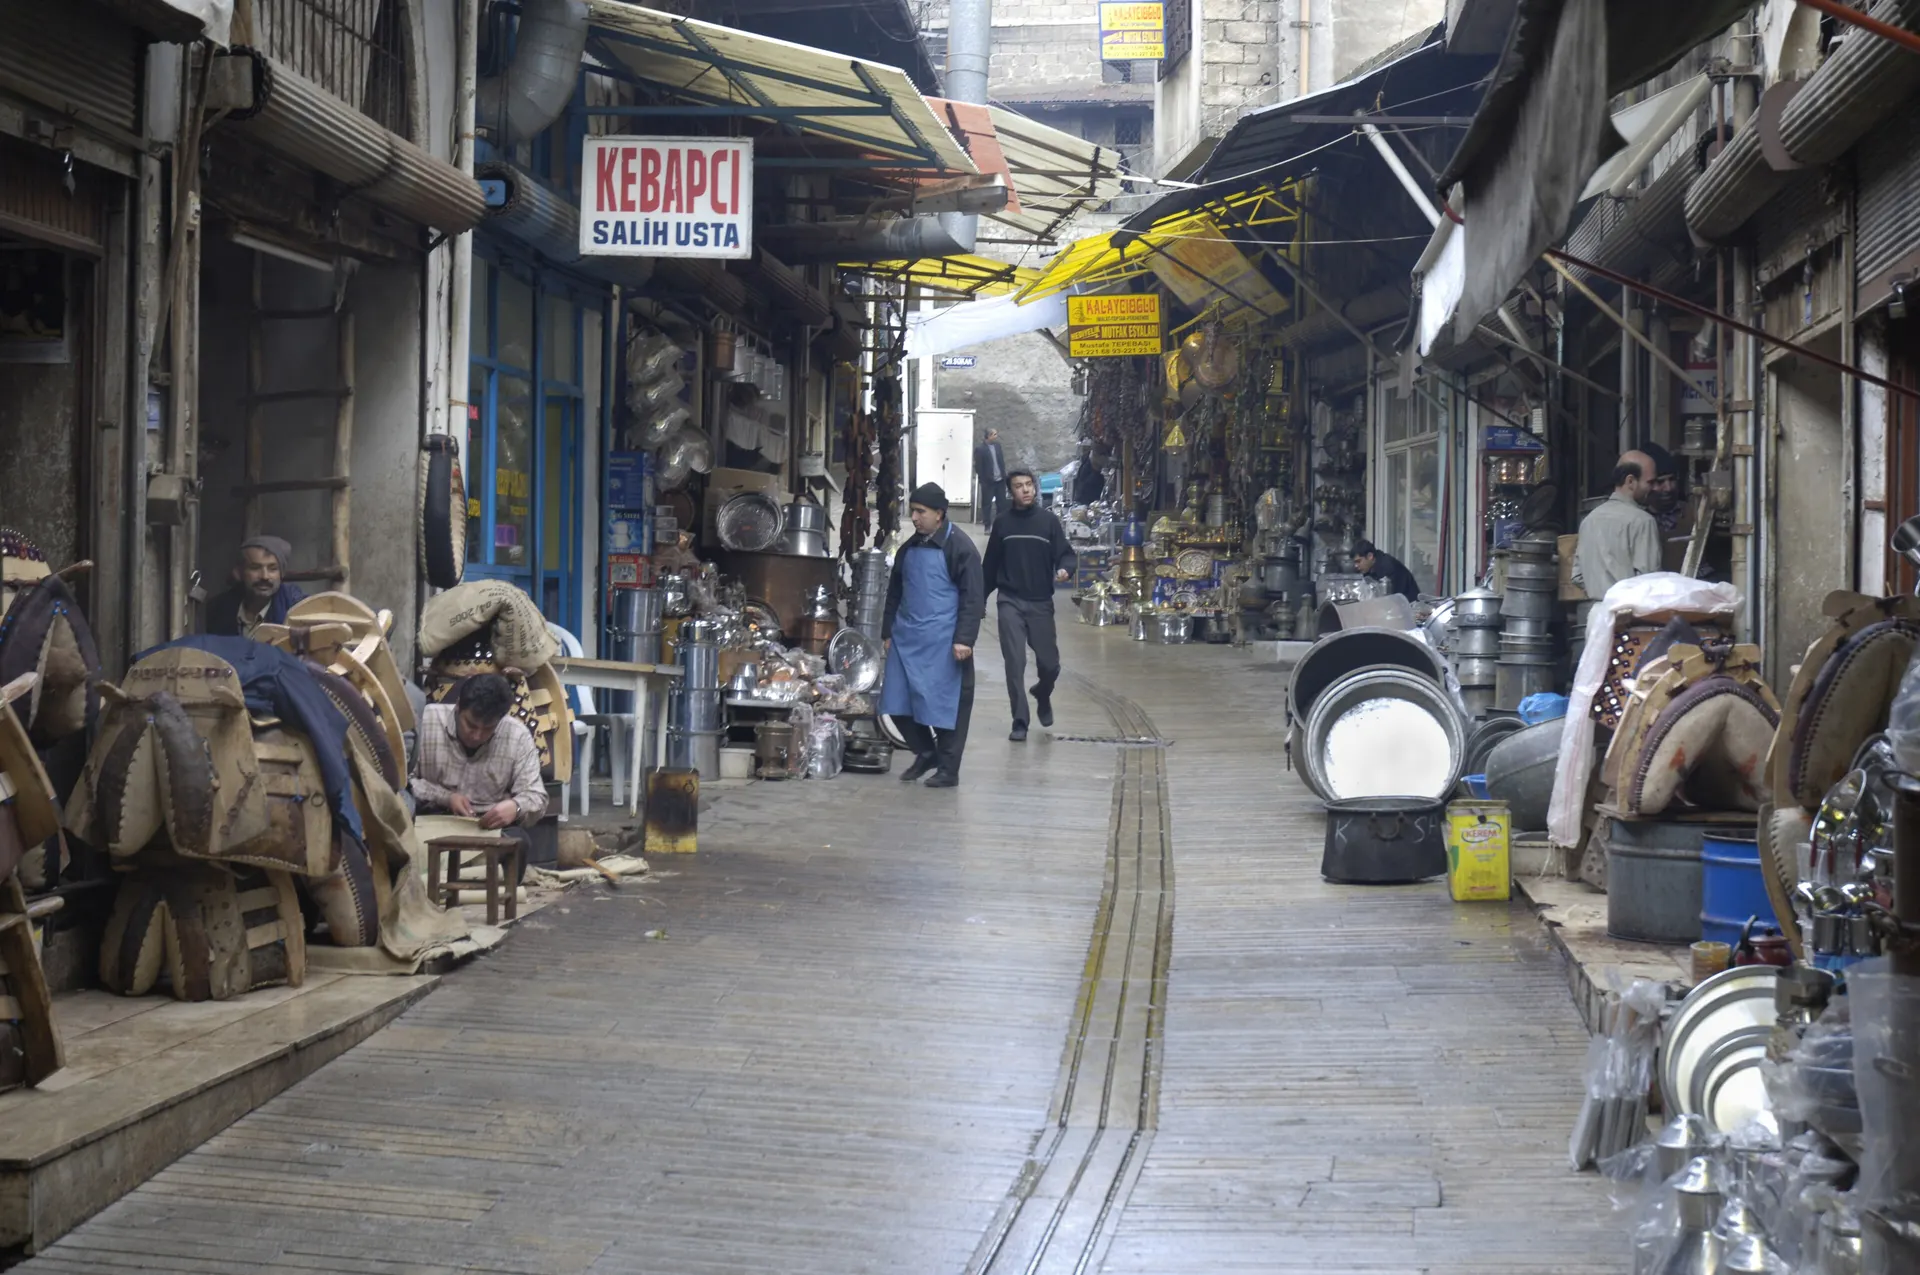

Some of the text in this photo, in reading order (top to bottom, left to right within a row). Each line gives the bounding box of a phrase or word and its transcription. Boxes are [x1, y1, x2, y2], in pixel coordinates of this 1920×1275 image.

[596, 147, 740, 215] KEBAPCI
[593, 218, 740, 247] SALİH USTA
[1101, 326, 1128, 339] MUTFAK
[1466, 829, 1498, 838] KEREM
